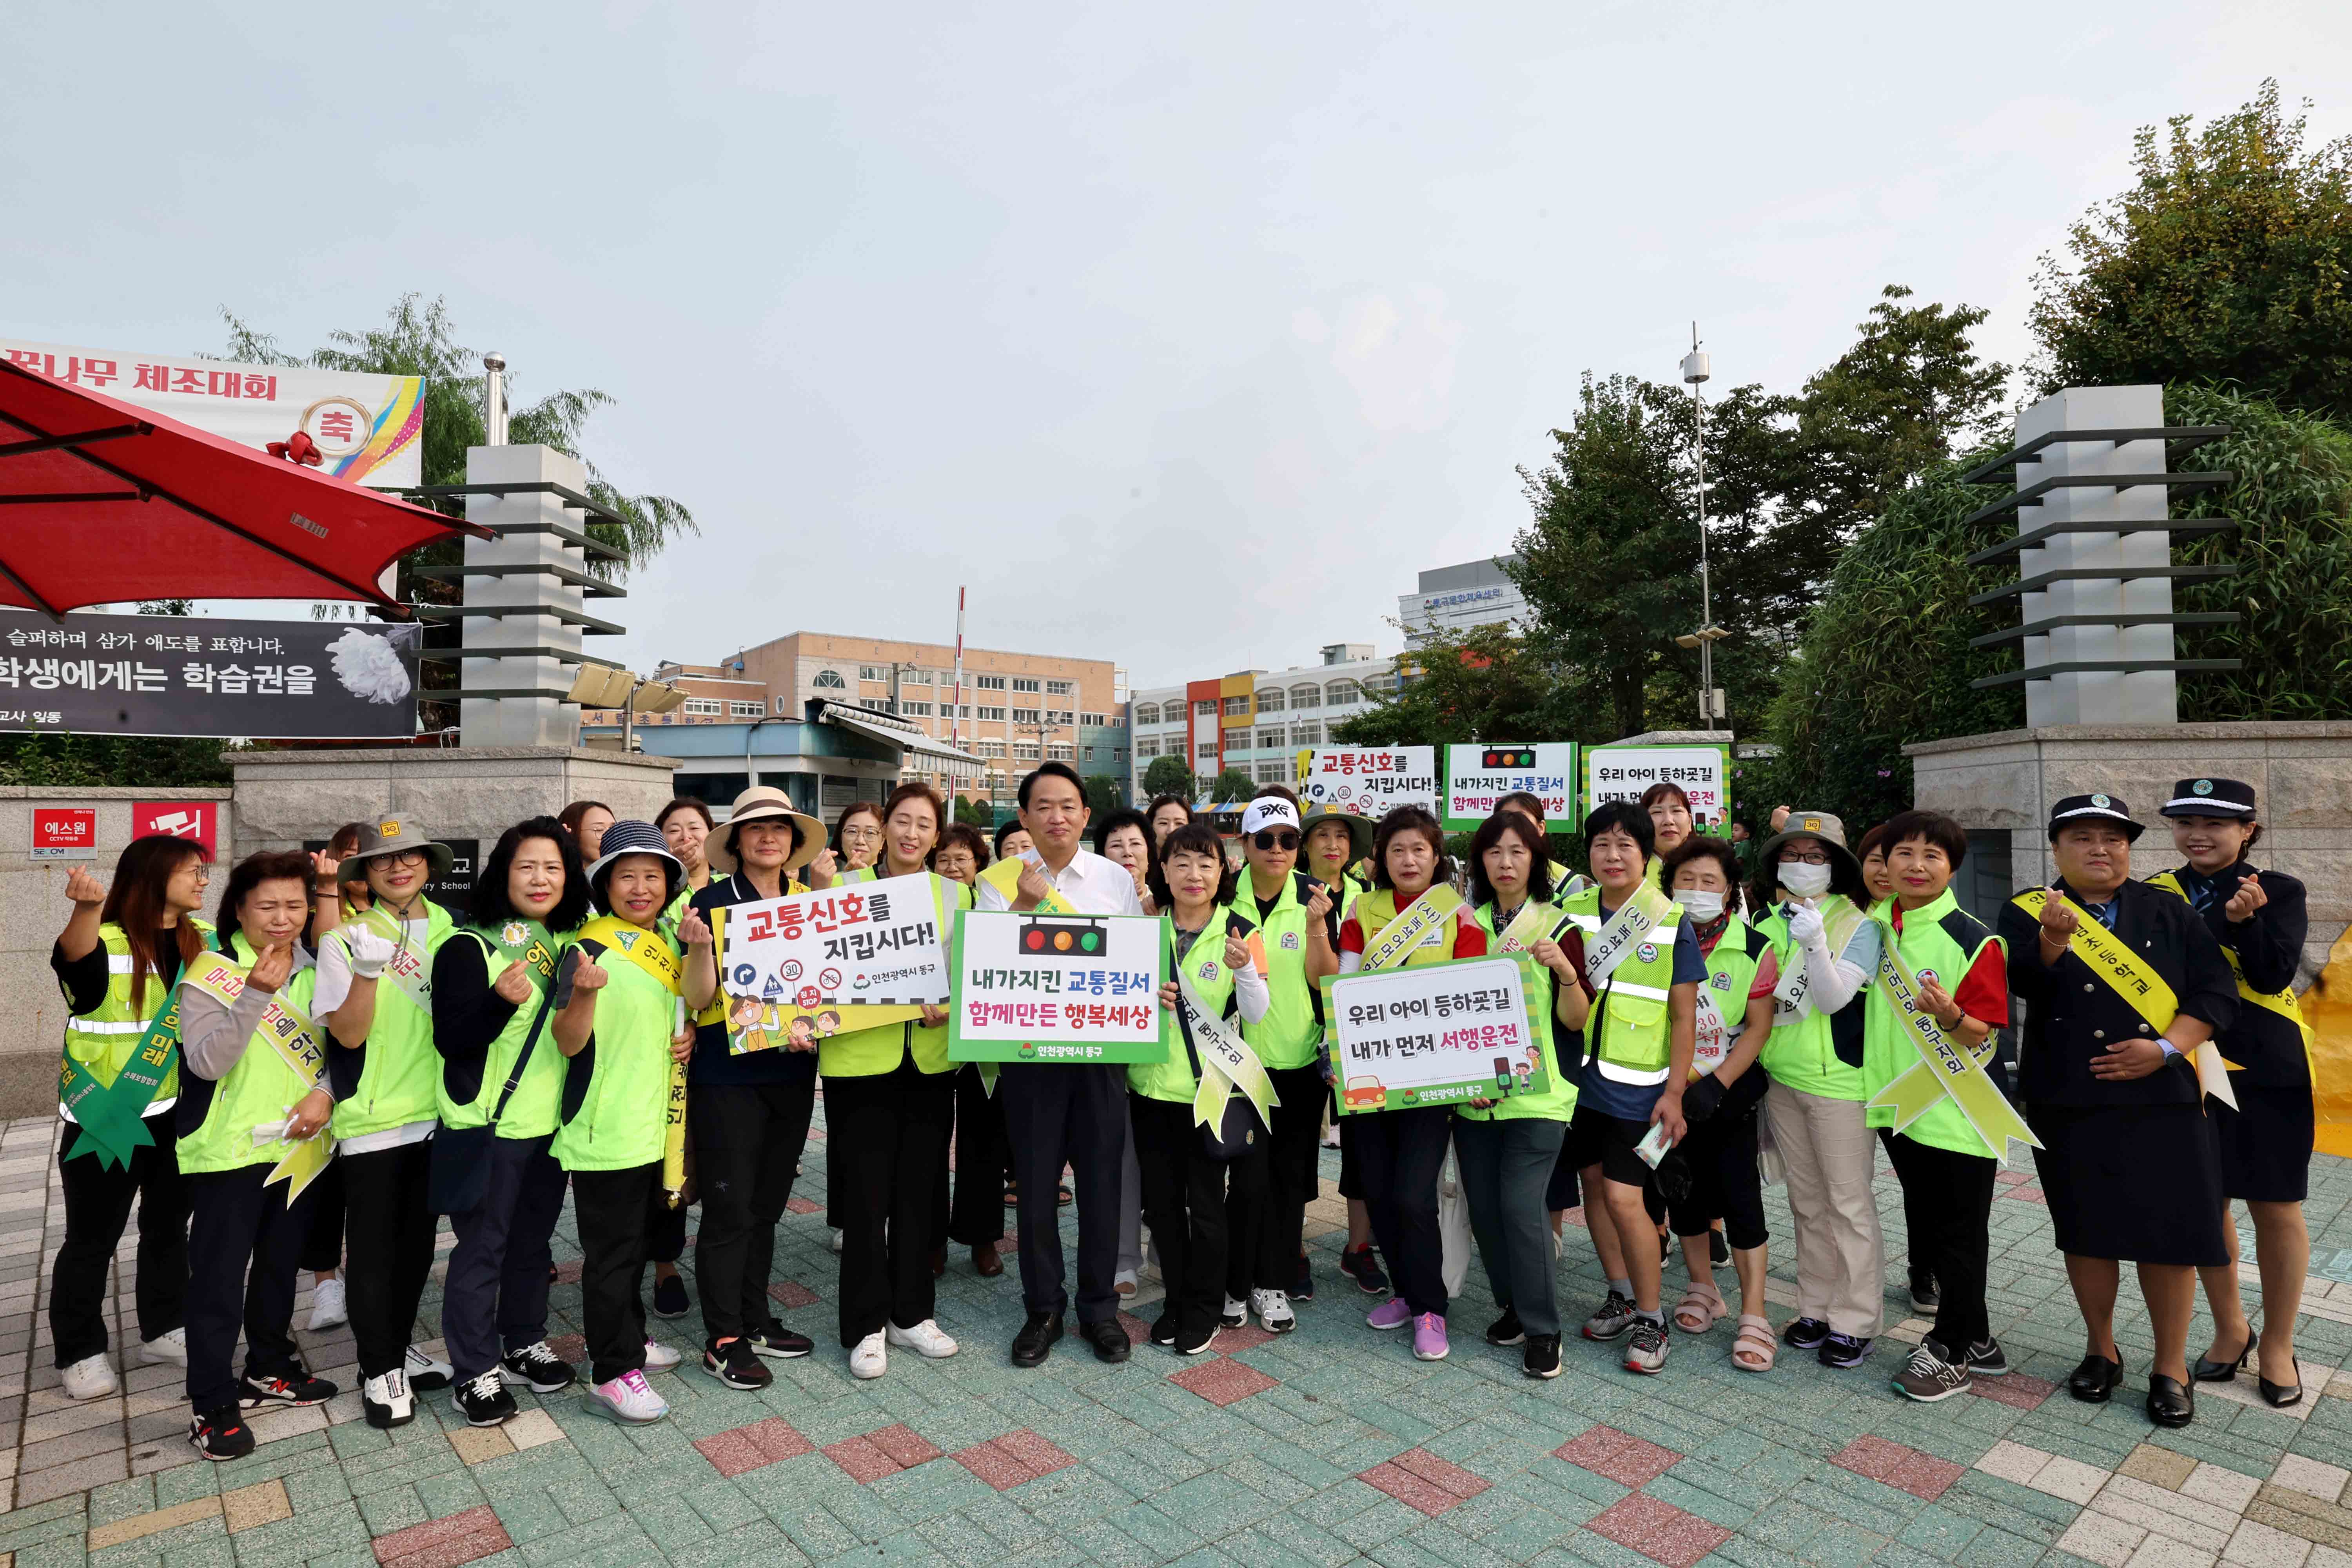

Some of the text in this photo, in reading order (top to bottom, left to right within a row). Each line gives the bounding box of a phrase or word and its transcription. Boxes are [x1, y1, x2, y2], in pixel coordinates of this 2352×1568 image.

[133, 363, 277, 401] 체조대회
[320, 412, 354, 443] 축
[6, 629, 285, 655] 슬퍼하며 삼가 애도를 표합니다.
[182, 662, 316, 694] 학습권을
[33, 711, 62, 723] 일동
[1322, 752, 1407, 775] 교통신호를
[1599, 768, 1712, 782] 우리 아이 등하굣길
[1365, 777, 1431, 793] 지킵시다!
[1455, 777, 1564, 791] 내가지킨 교통질서
[1539, 797, 1565, 812] 세상
[45, 822, 85, 835] 에스원
[747, 893, 891, 942] 교통신호를
[824, 922, 935, 961] 지킵시다!
[785, 964, 798, 975] 30
[871, 964, 936, 984] 인천광역시 동구
[972, 969, 1150, 995] 내가지킨 교통질서
[802, 998, 817, 1006] STOP
[969, 1001, 1152, 1029] 함께만든 행복세상
[1348, 987, 1511, 1026] 우리 아이 등하굣길
[142, 1033, 174, 1067] 미래
[1038, 1046, 1103, 1058] 인천광역시 동구
[1198, 1022, 1244, 1066] 동구지회
[1351, 1023, 1519, 1060] 내가 먼저 서행운전
[1915, 1016, 1966, 1074] 동구지회
[1419, 1085, 1483, 1102] 인천광역시 동구
